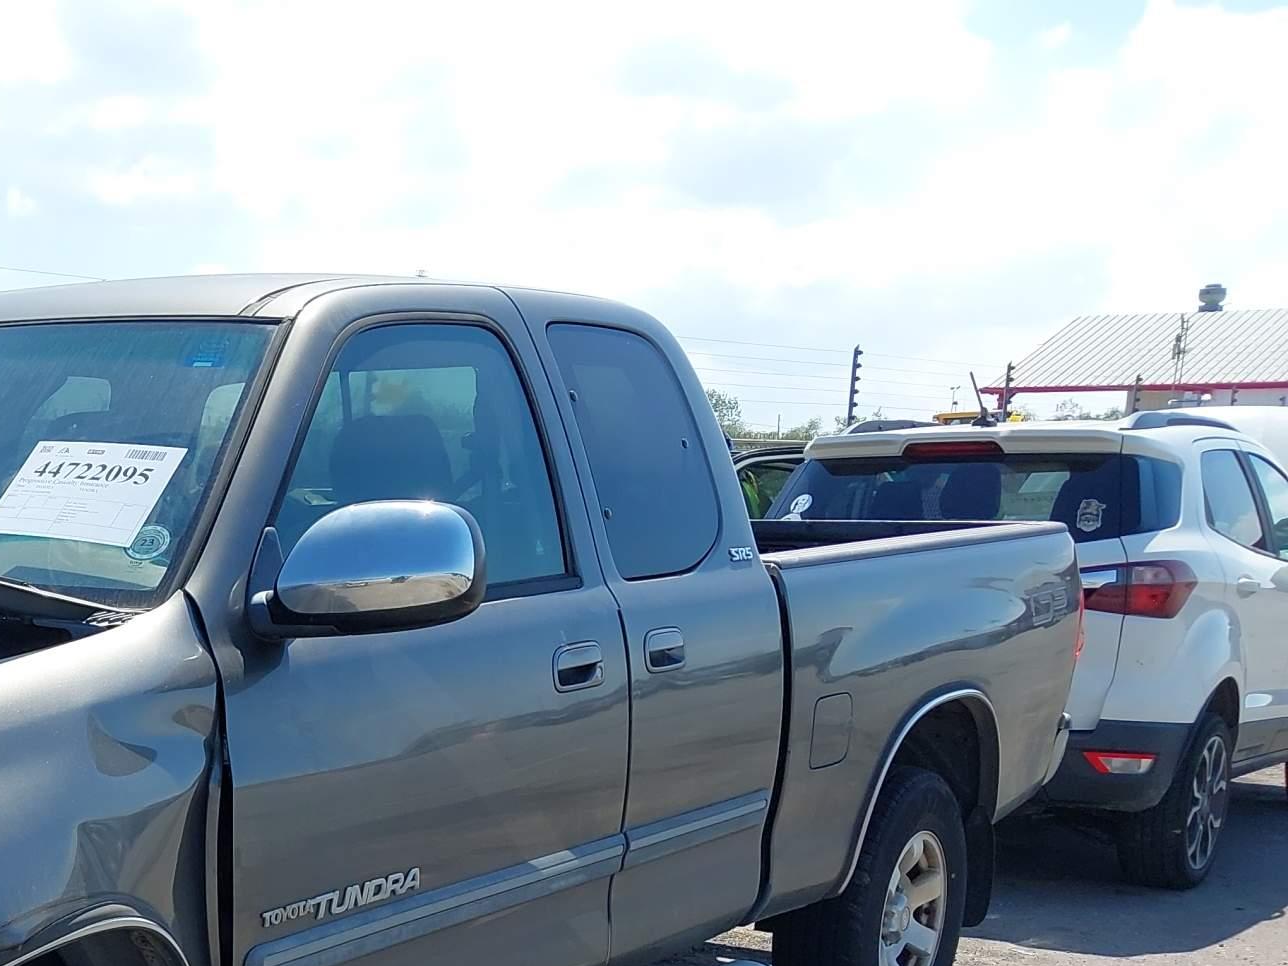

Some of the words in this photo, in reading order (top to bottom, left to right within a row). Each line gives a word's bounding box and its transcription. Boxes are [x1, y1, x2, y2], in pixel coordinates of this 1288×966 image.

[34, 460, 156, 486] 44722095
[140, 538, 155, 547] 23
[728, 546, 754, 562] SR5
[261, 897, 314, 928] TOYOTA
[312, 867, 421, 920] TUNDRA
